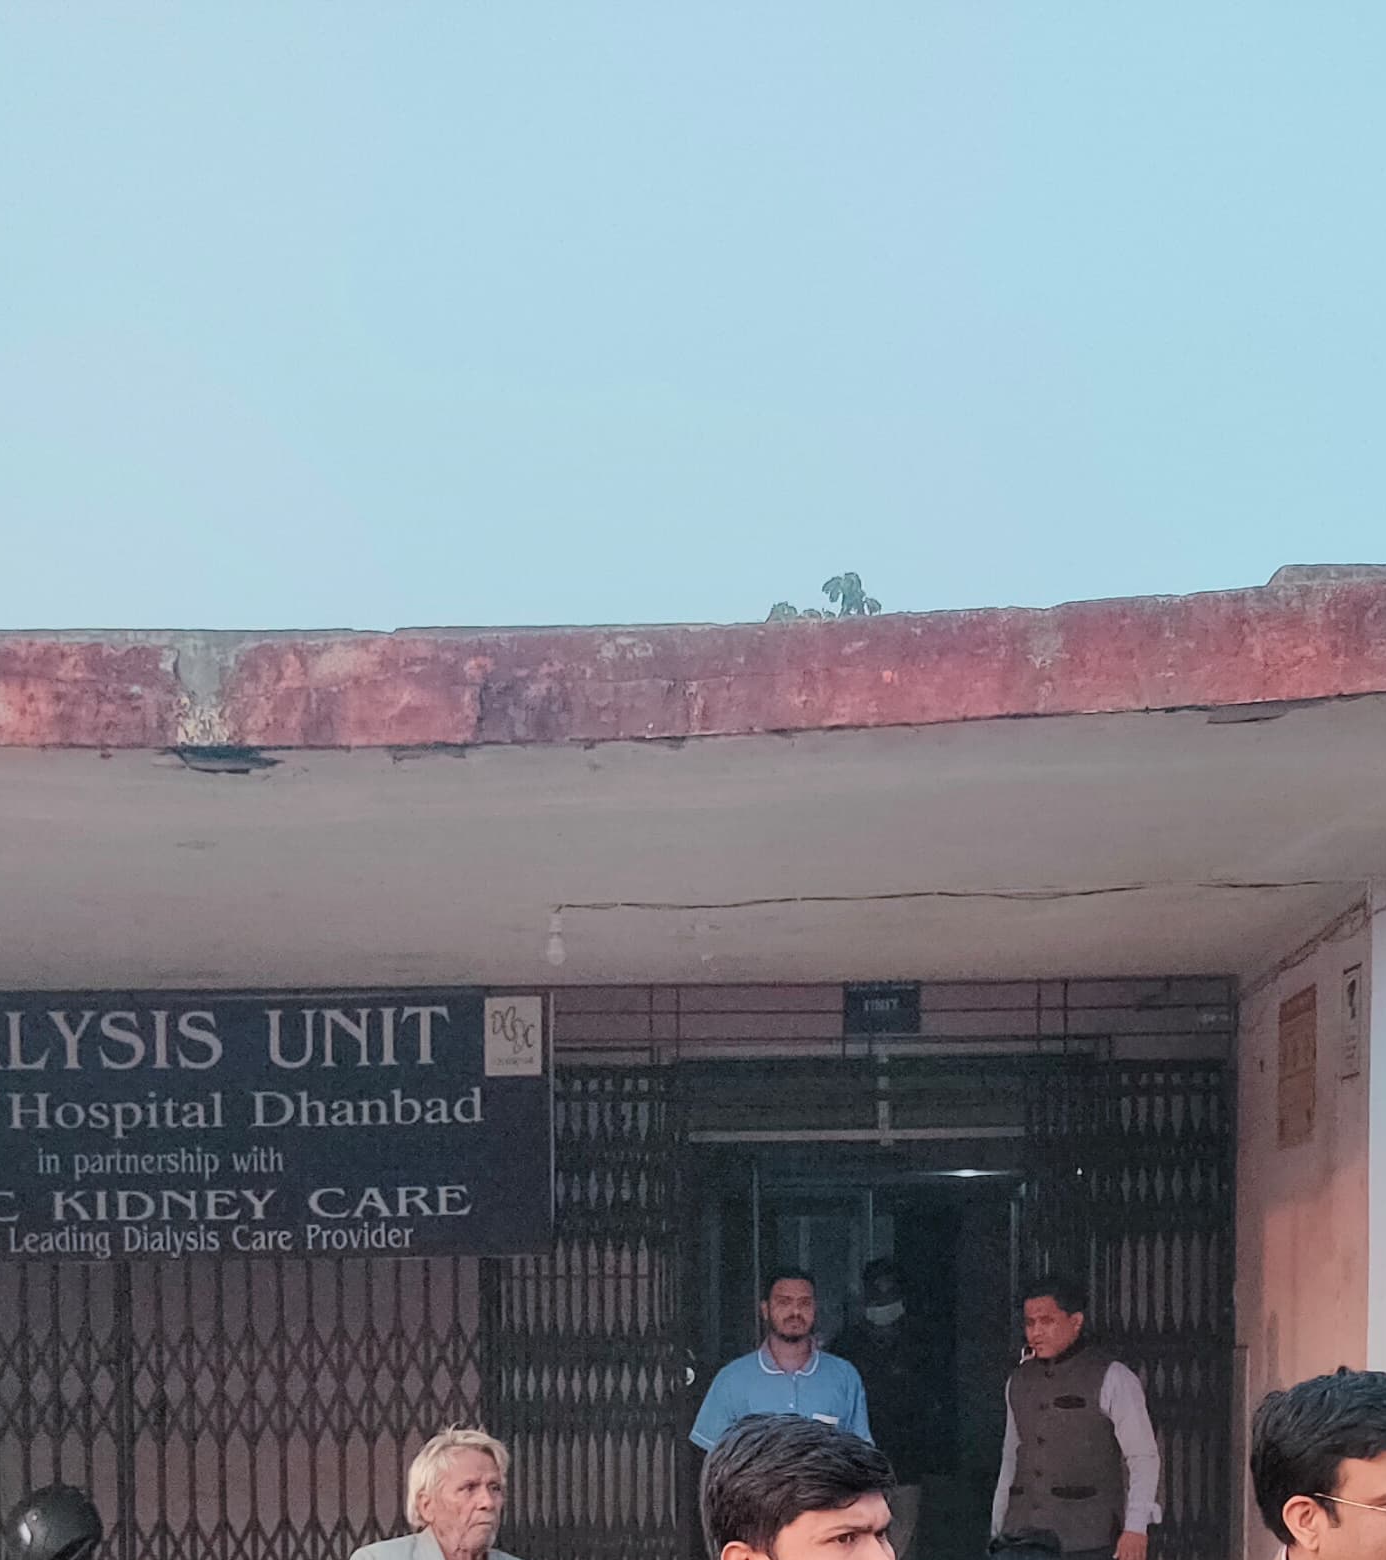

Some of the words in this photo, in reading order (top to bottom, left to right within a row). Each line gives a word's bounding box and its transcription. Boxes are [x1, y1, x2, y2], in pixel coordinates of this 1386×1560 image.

[264, 1005, 451, 1070] UNIT
[8, 1090, 224, 1139] Hospital
[251, 1087, 485, 1129] Dhanbad
[38, 1148, 60, 1174] in
[74, 1146, 220, 1181] partnership
[232, 1146, 284, 1173] with
[52, 1189, 277, 1222] KIDNEY
[308, 1185, 473, 1219] CARE
[9, 1226, 111, 1260] Leading
[123, 1224, 220, 1260] Dialysis
[232, 1225, 293, 1251] Care
[307, 1222, 414, 1249] Provider
